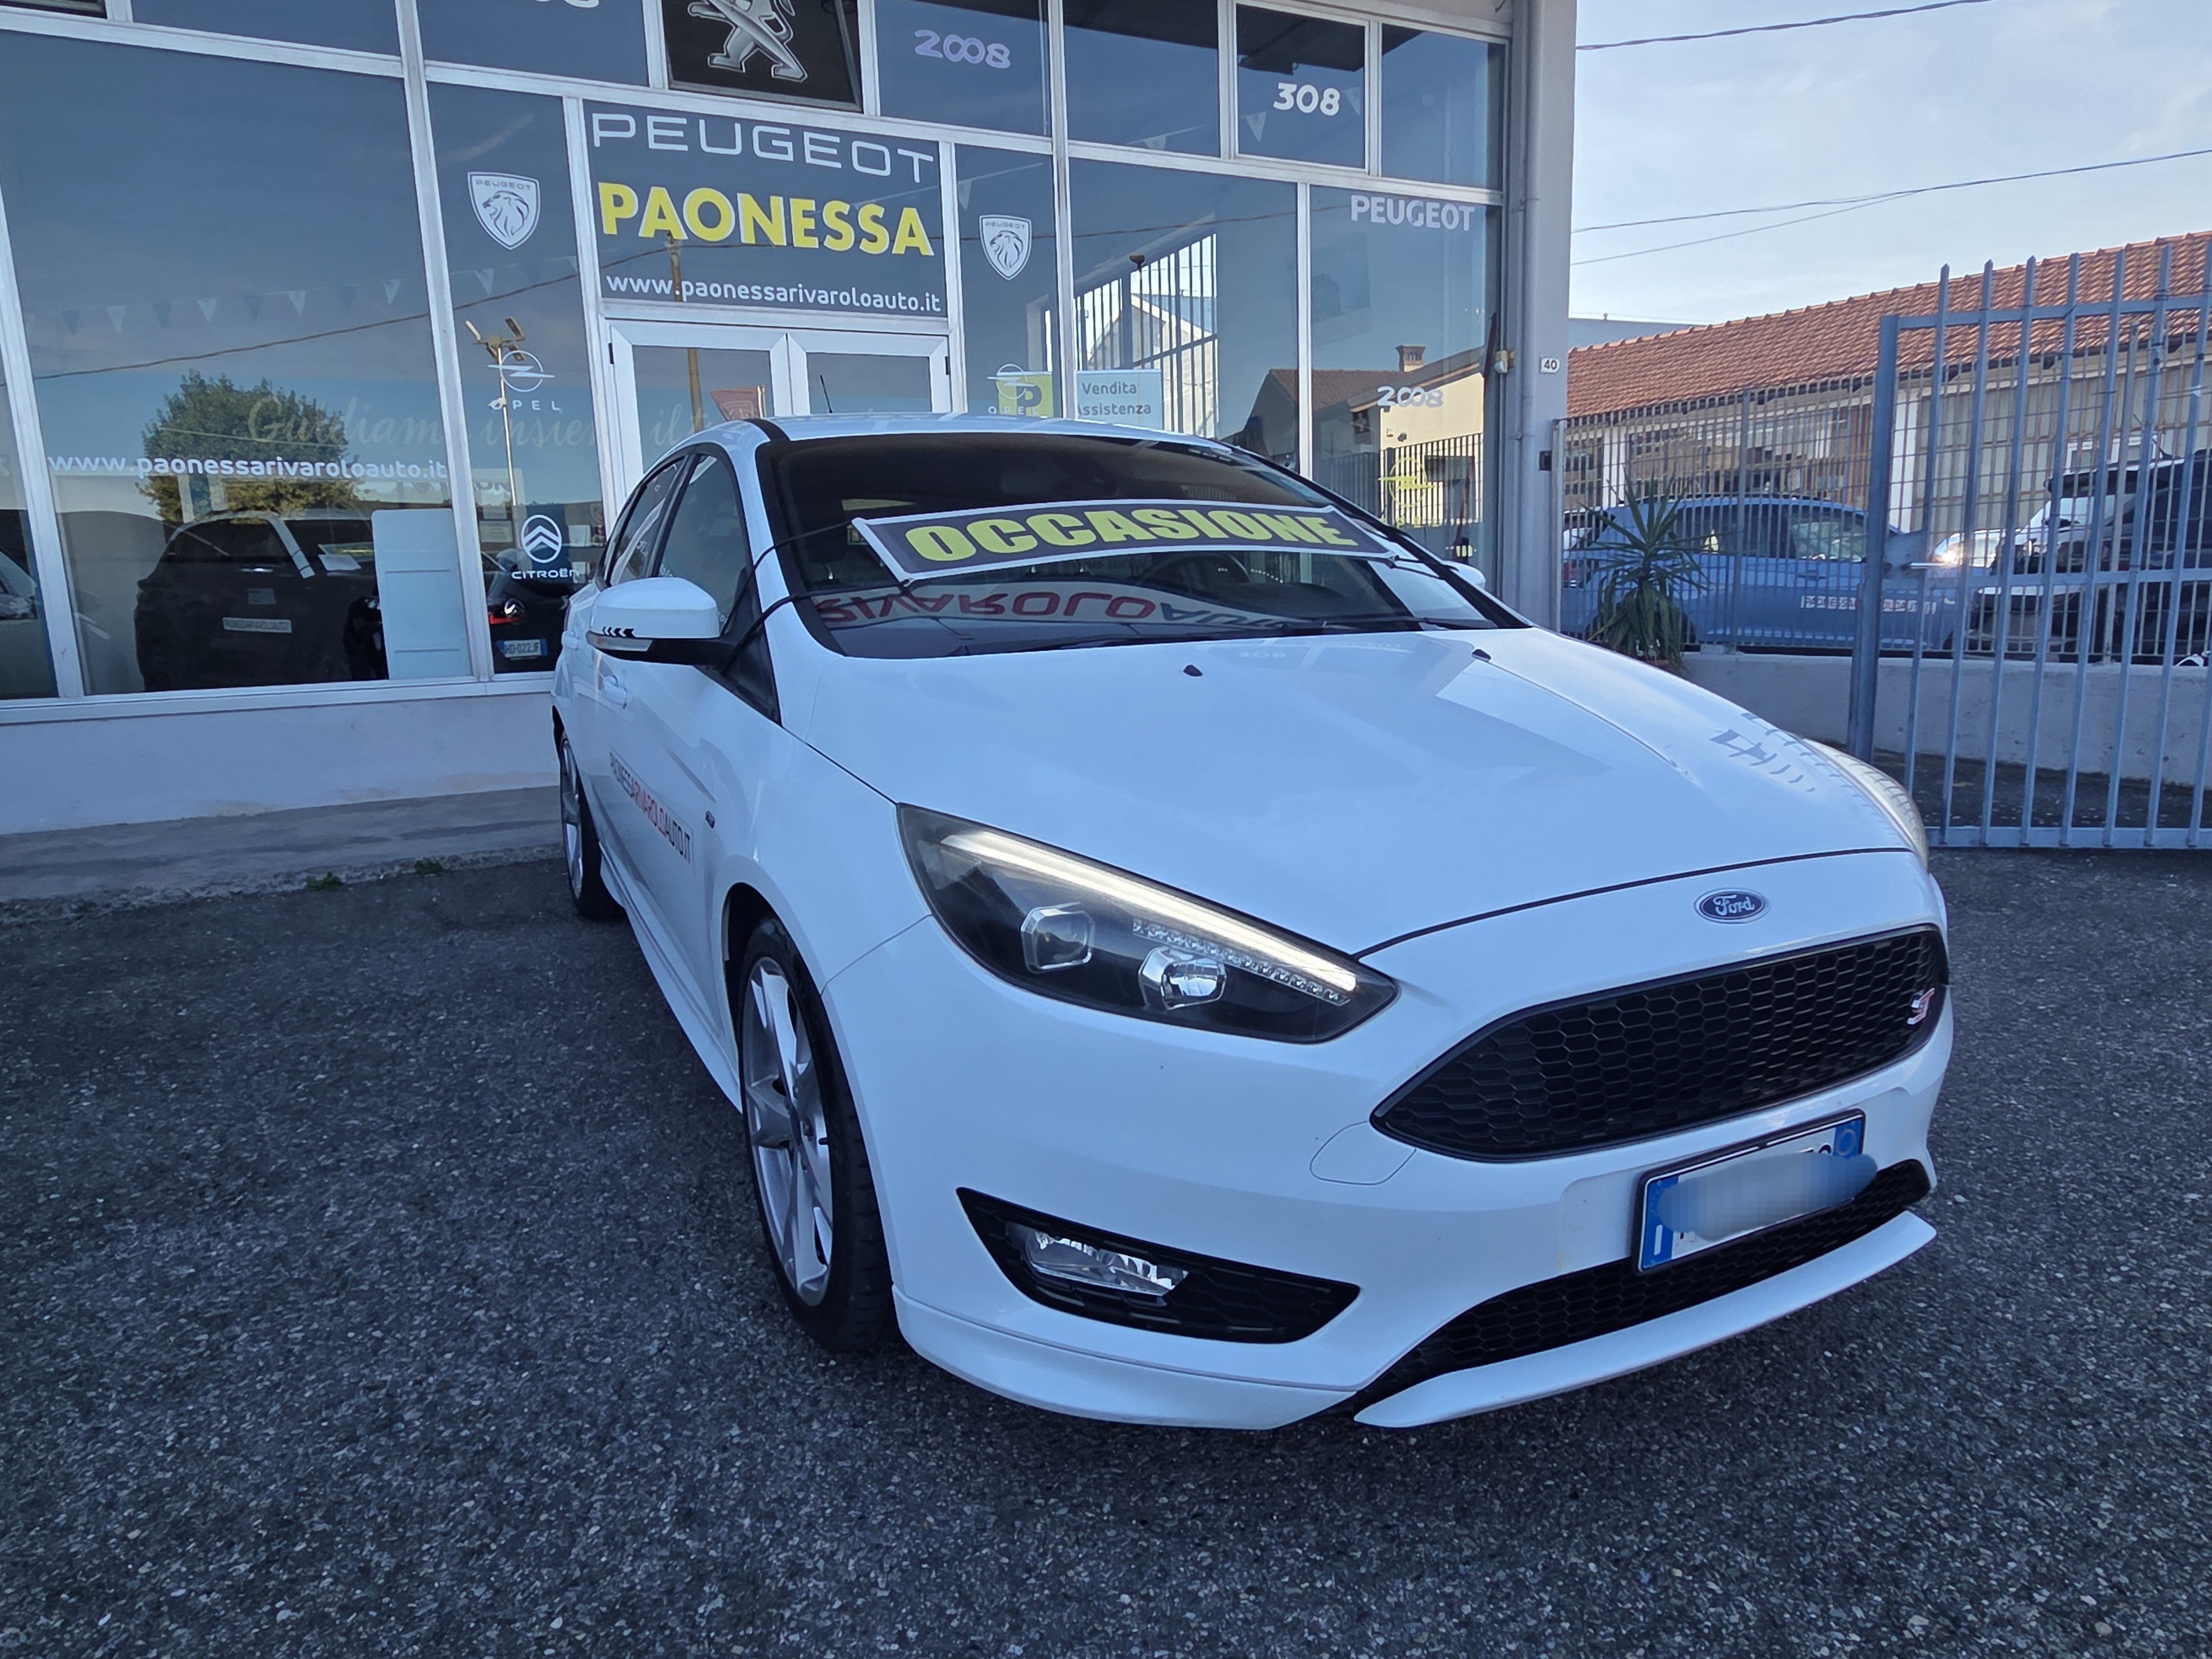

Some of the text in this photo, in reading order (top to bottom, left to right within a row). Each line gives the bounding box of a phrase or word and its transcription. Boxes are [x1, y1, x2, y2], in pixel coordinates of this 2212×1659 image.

[914, 29, 1011, 68] 2008
[1273, 82, 1340, 116] 308
[592, 113, 934, 183] PEUGEOT
[476, 179, 531, 190] PEUGEOT
[597, 181, 935, 257] PAONESSA
[1350, 195, 1475, 231] PEUGEOT
[606, 274, 942, 312] www.paonessarivaroloauto.it
[1543, 359, 1557, 371] 40
[1082, 380, 1138, 395] Vendita
[1377, 386, 1444, 408] 2008
[48, 455, 448, 481] www.paonessarivaroloauto.it
[905, 509, 1358, 562] OCCASIONE
[1712, 894, 1755, 916] Ford
